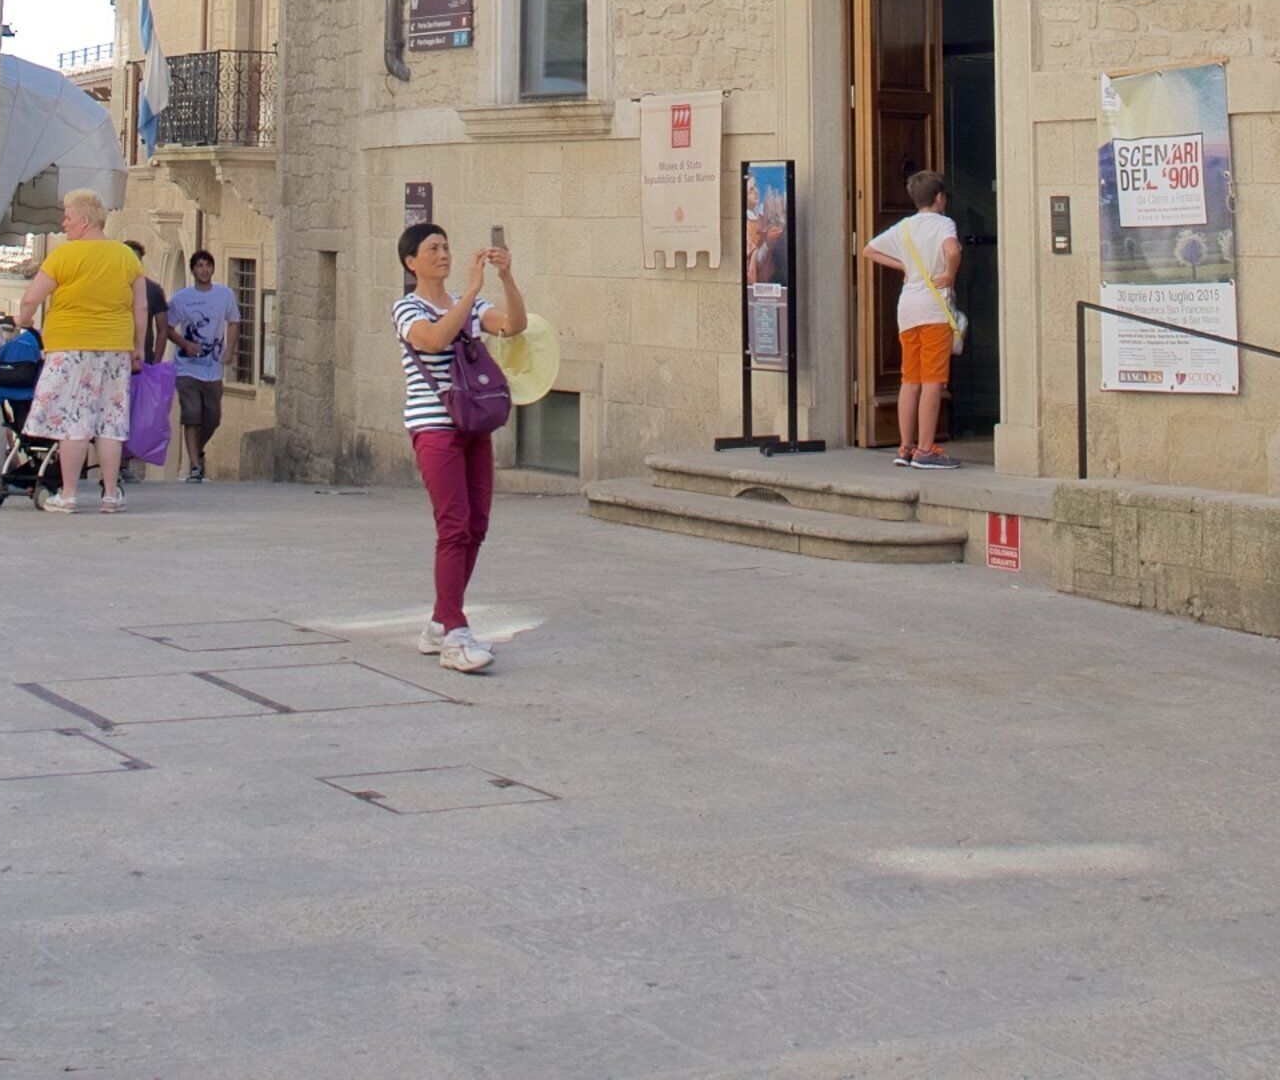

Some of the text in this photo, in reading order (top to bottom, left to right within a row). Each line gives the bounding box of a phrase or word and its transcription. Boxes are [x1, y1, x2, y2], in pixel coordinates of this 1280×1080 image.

[1118, 141, 1198, 168] SCENARI
[658, 160, 703, 171] Museo di Stato
[1120, 168, 1158, 191] DEL
[1155, 290, 1165, 302] 31
[1197, 289, 1220, 301] 2015
